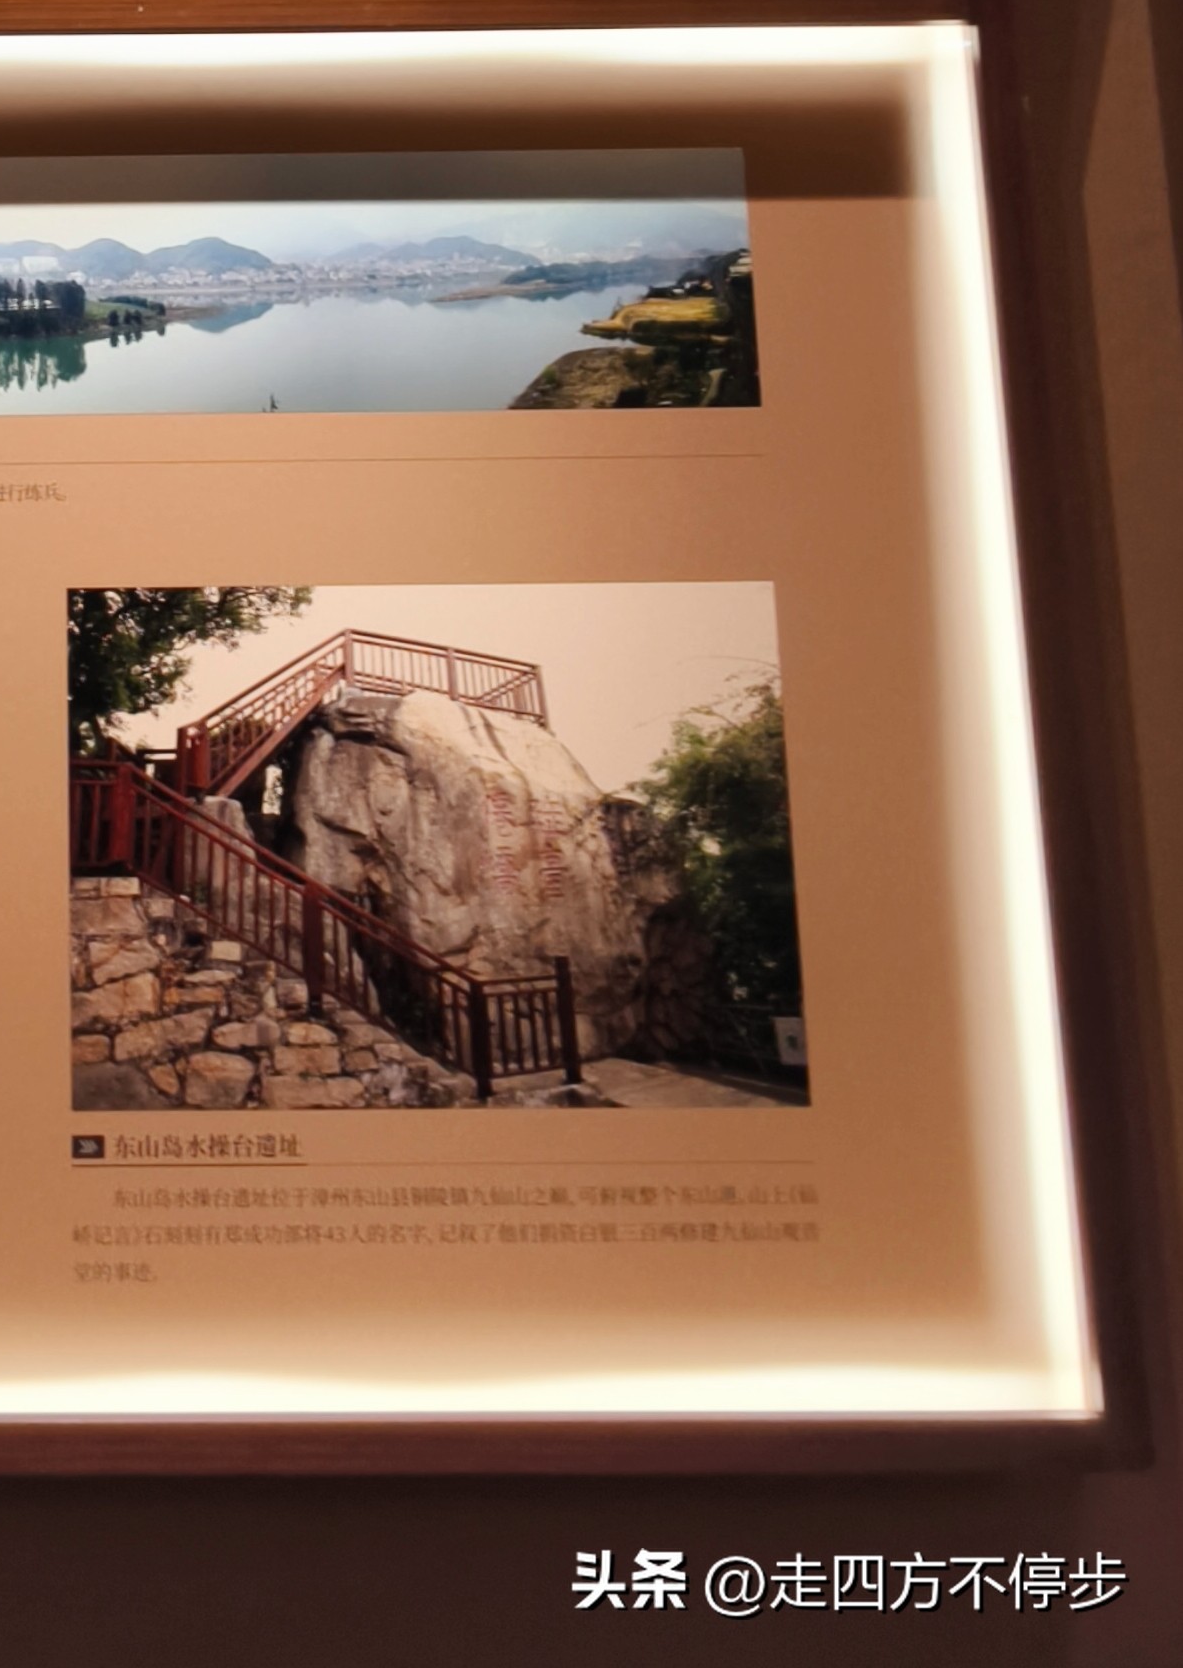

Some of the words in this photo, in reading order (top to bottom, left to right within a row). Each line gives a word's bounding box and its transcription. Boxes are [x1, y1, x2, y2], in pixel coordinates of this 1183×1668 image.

[113, 1133, 303, 1159] 东山岛水操台遗址
